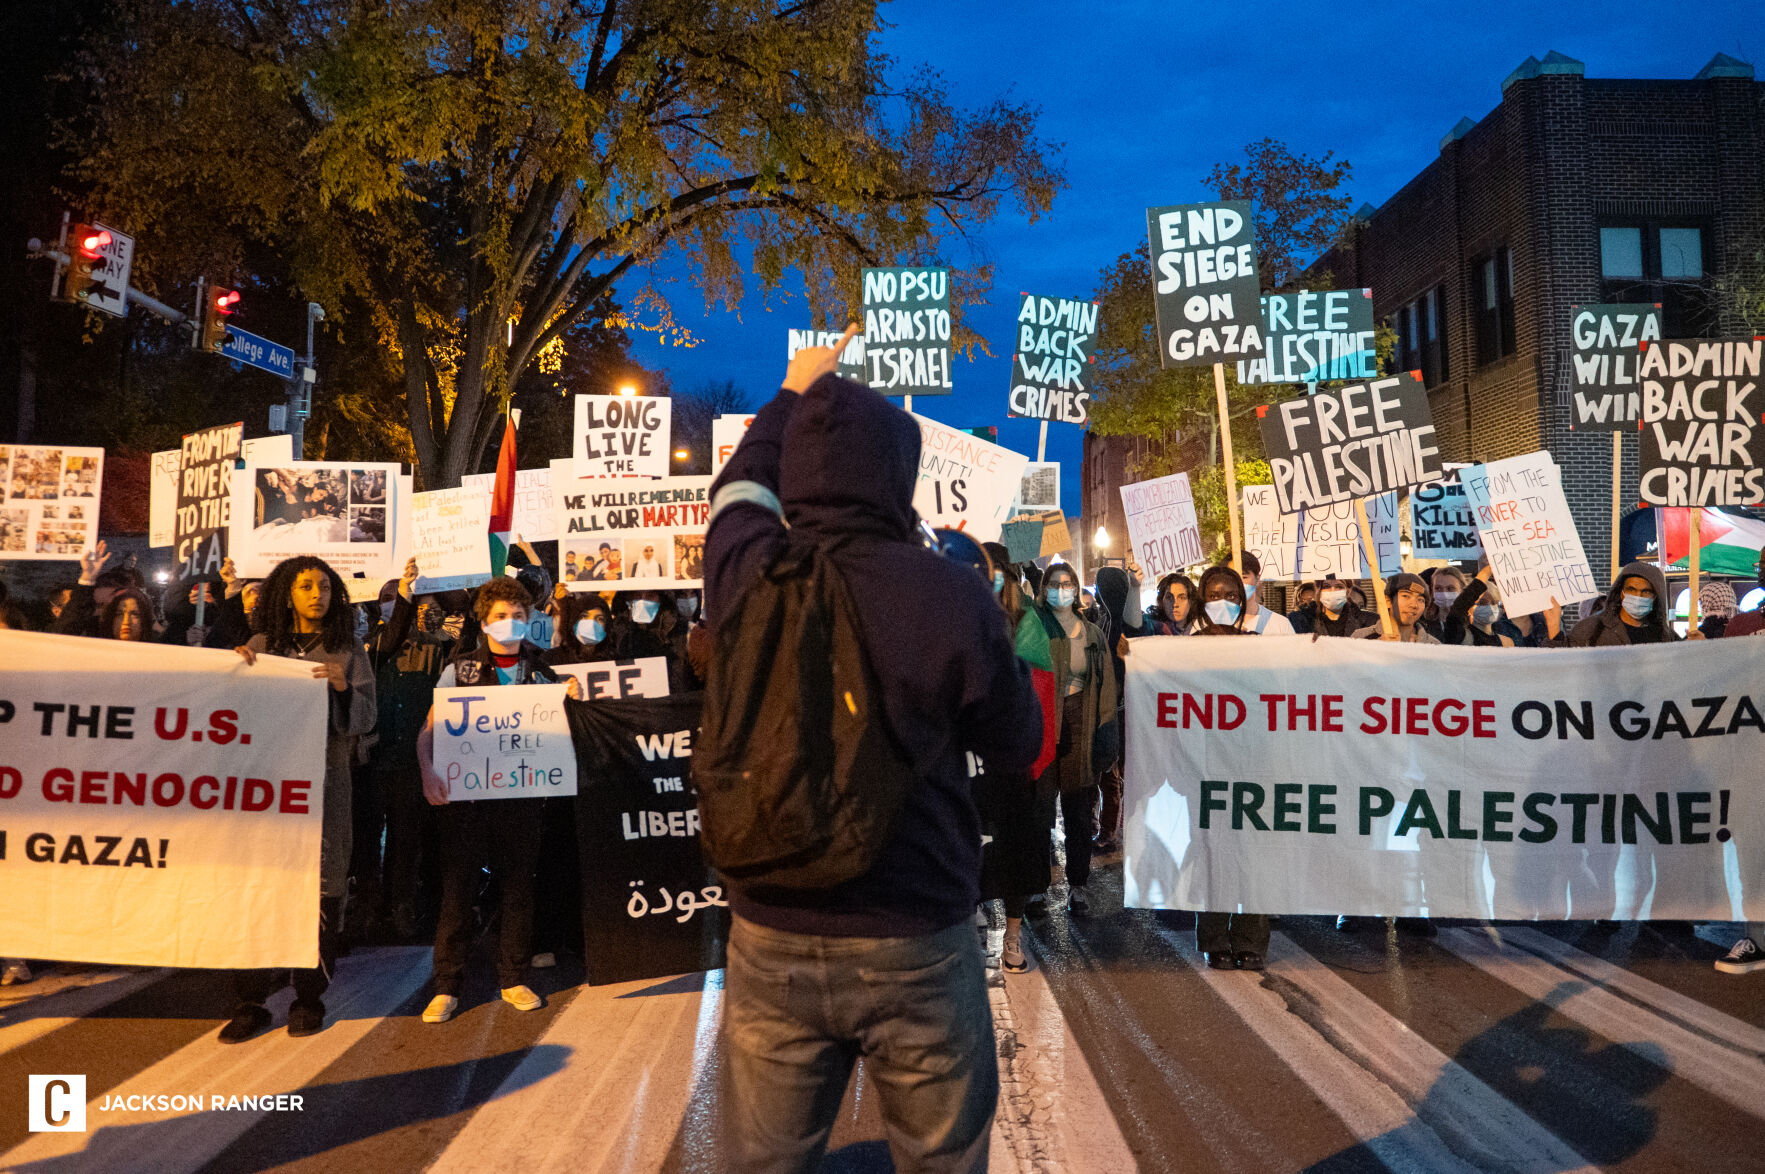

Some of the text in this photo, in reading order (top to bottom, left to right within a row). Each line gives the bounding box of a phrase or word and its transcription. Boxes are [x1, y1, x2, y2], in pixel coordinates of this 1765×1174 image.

[1159, 208, 1243, 250] END
[864, 271, 947, 305] NO PSU
[1157, 244, 1254, 295] SIEGE
[864, 308, 951, 344] ARMS TO
[1017, 295, 1099, 334] ADMIN
[1183, 293, 1235, 322] ON
[1261, 291, 1350, 331] REE
[1020, 325, 1088, 363] BACK
[1168, 325, 1263, 361] GAZA
[1573, 311, 1661, 349] GAZA
[268, 348, 290, 370] Ave.
[866, 347, 953, 388] ISRAEL
[1019, 354, 1085, 391] WAR
[1237, 331, 1377, 385] ALESTINE
[1640, 341, 1762, 378] ADMIN
[587, 400, 661, 431] LONG
[1009, 385, 1090, 423] CRIMES
[1279, 377, 1406, 450] FREE
[1643, 380, 1757, 428] BACK
[181, 430, 222, 470] FROM
[585, 432, 652, 459] LIVE
[1652, 421, 1754, 466] WAR
[603, 460, 634, 473] THE
[1270, 425, 1443, 514] PALESTINE
[564, 494, 586, 510] WE
[591, 493, 627, 507] WILL
[935, 479, 968, 514] IS
[1247, 490, 1269, 506] WE
[1470, 472, 1517, 502] FROM
[1517, 469, 1549, 488] THE
[1639, 466, 1765, 507] CRIMES
[177, 496, 231, 536] TO THE
[568, 515, 605, 533] ALL
[607, 508, 640, 529] OUR
[1380, 524, 1392, 534] IN
[1477, 496, 1546, 525] RIVER TO
[1142, 524, 1202, 578] REVOLUTION
[1414, 528, 1478, 549] HE WAS
[1485, 519, 1557, 549] THE SEA
[178, 531, 222, 581] SEA
[1493, 539, 1577, 576] PALESTINE
[1498, 562, 1595, 601] WILL BE FREE
[33, 702, 136, 740] THE
[154, 707, 252, 745] U.S.
[444, 696, 522, 737] Jews
[1156, 692, 1765, 741] END THE SIEGE ON GAZA
[460, 733, 545, 755] a FREE
[636, 729, 693, 761] WE
[41, 767, 312, 815] GENOCIDE
[653, 777, 685, 794] THE
[1199, 780, 1731, 845] FREE PALESTINE!
[25, 832, 170, 869] GAZA!
